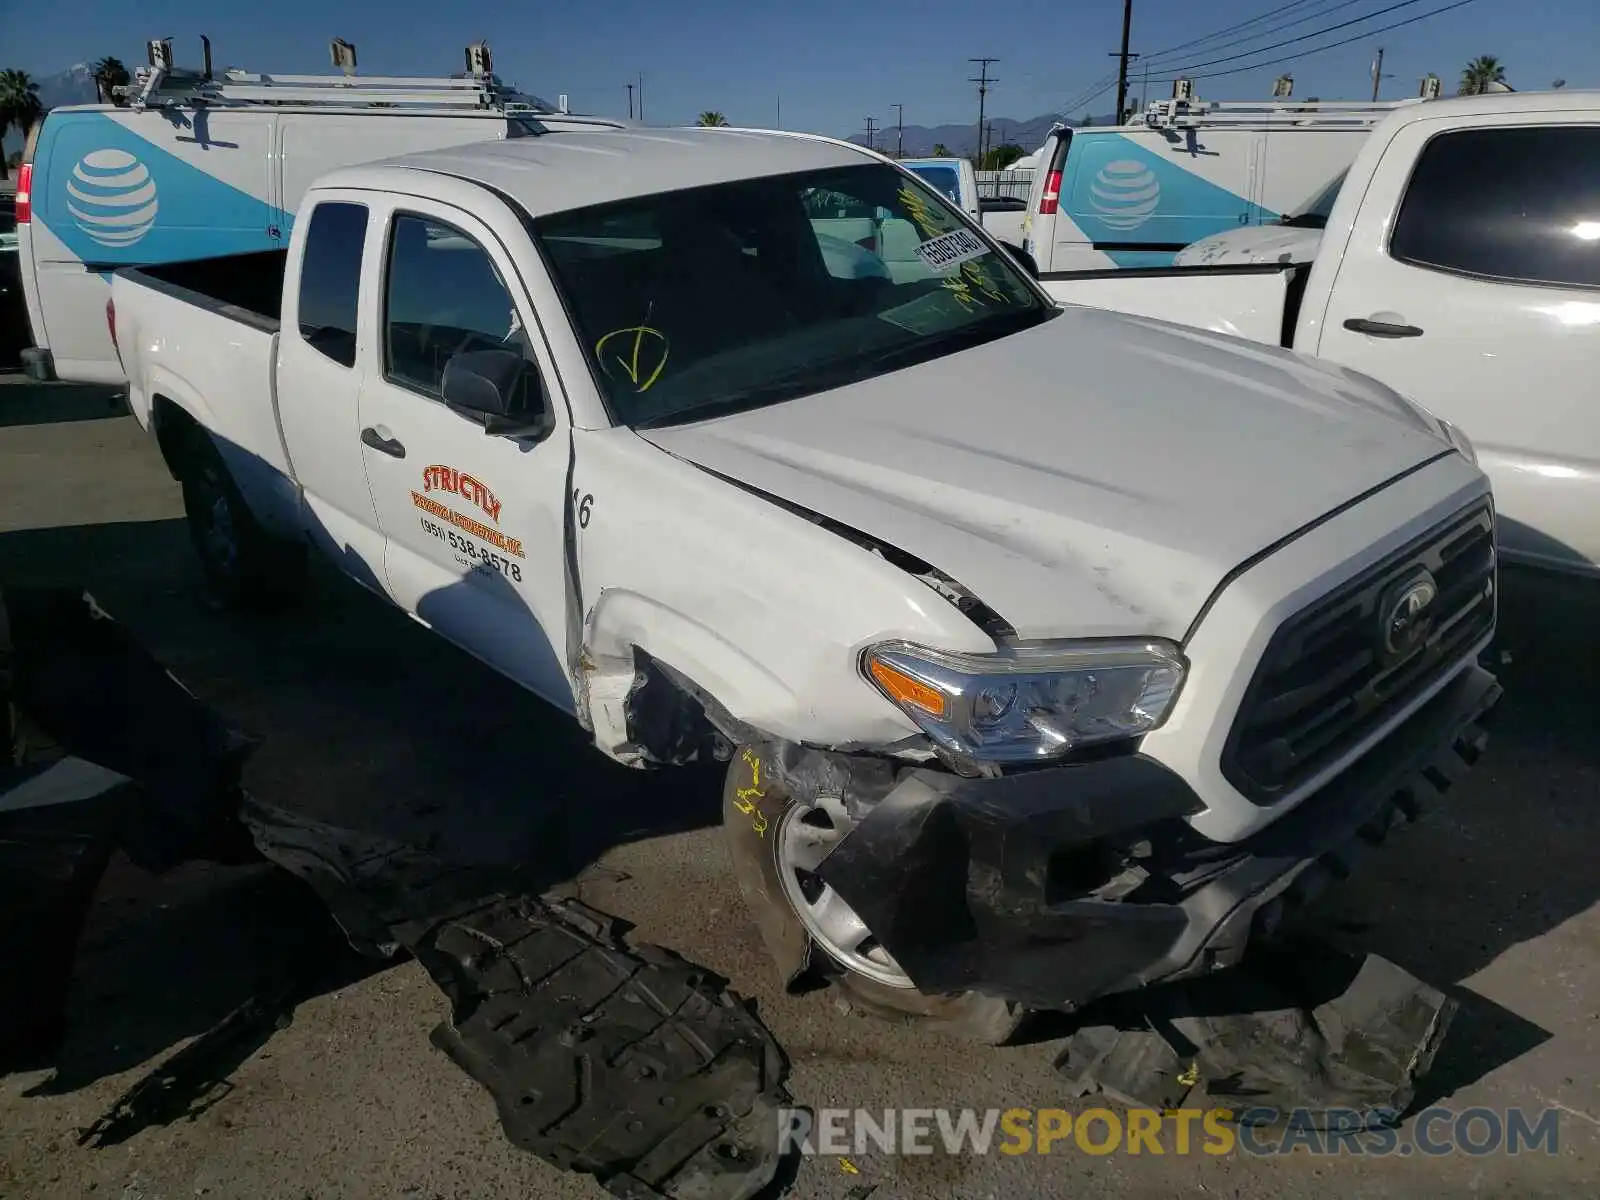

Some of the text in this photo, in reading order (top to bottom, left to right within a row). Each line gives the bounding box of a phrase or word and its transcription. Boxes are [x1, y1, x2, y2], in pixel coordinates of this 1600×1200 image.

[423, 464, 502, 523] STRICTLY
[420, 517, 446, 543] (951)
[449, 531, 522, 582] 538-8578
